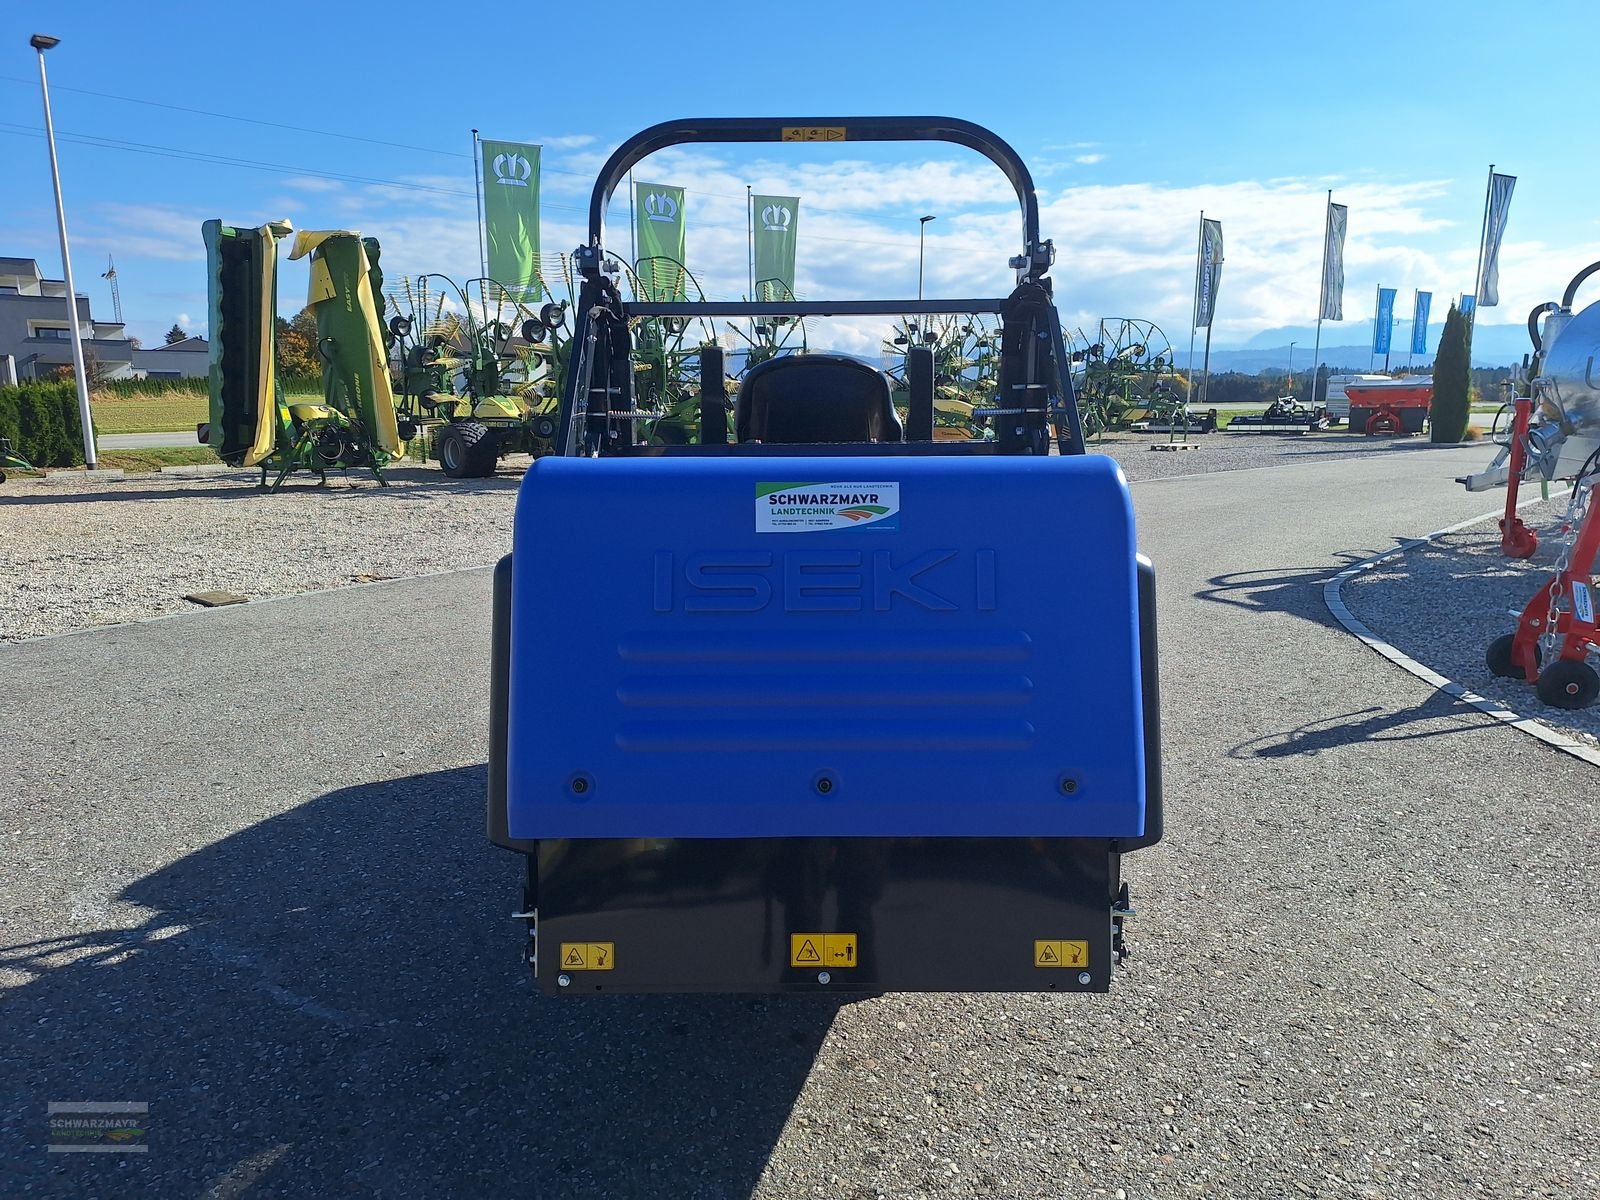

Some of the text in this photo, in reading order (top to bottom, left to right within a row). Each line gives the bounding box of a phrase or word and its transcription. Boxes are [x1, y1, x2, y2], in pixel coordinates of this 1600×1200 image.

[769, 494, 879, 505] SCHWARZMAYR
[771, 507, 835, 516] LANDTECHNIK
[653, 549, 995, 612] ISEKI
